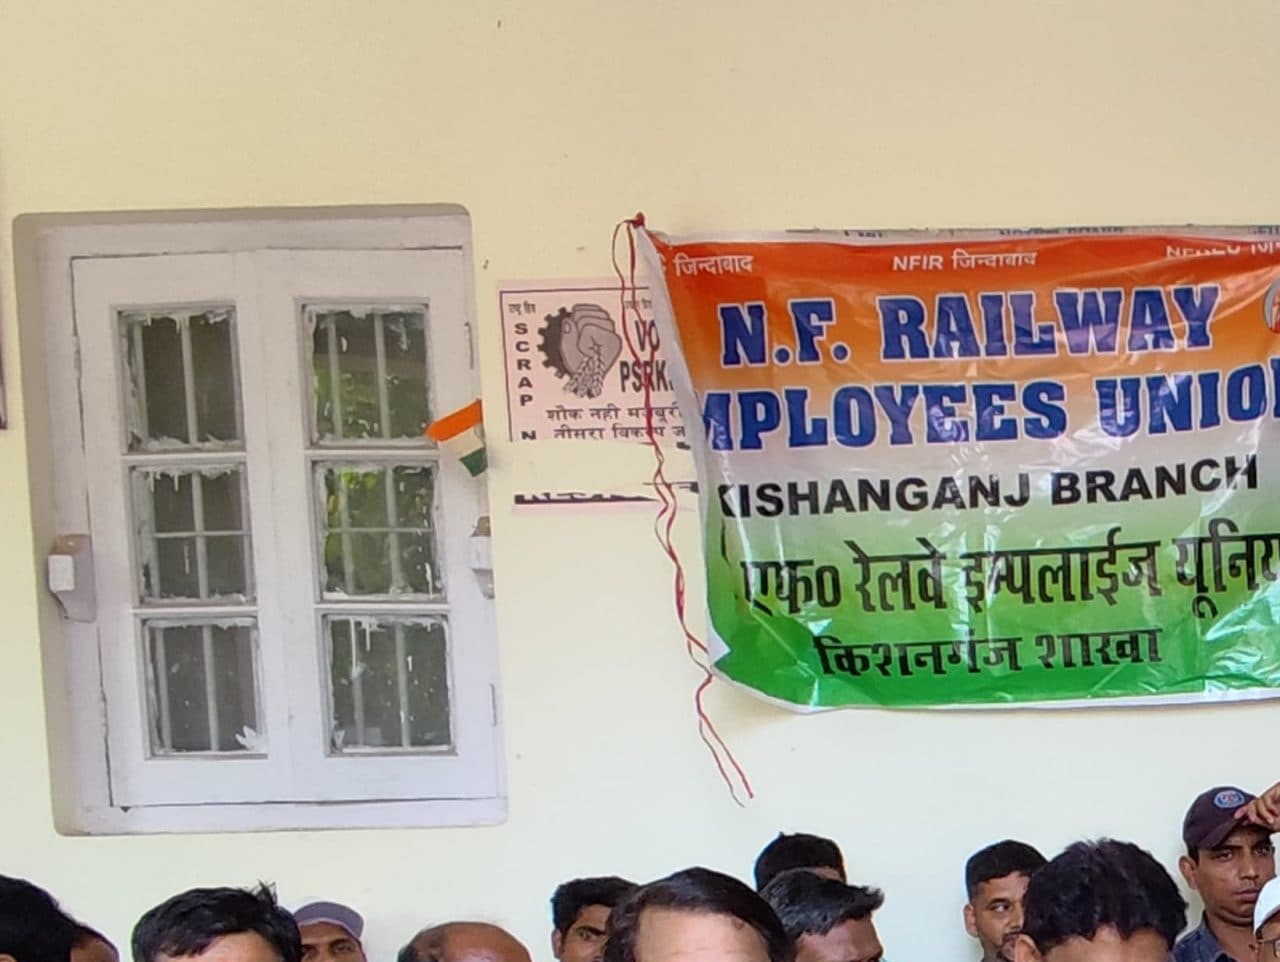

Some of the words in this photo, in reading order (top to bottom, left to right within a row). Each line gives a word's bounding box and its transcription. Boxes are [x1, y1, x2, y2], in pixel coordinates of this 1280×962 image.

[892, 254, 944, 271] NFIR
[720, 299, 850, 367] N.F.
[876, 284, 1220, 362] RAILWAY
[514, 322, 533, 406] SCRAP
[612, 423, 665, 439] विकप
[702, 379, 1068, 452] MPLOYEES
[1051, 456, 1258, 505] BRANCH
[845, 537, 947, 613] रेलवे
[813, 629, 1023, 677] किशनगंज
[1035, 628, 1163, 669] शाखा
